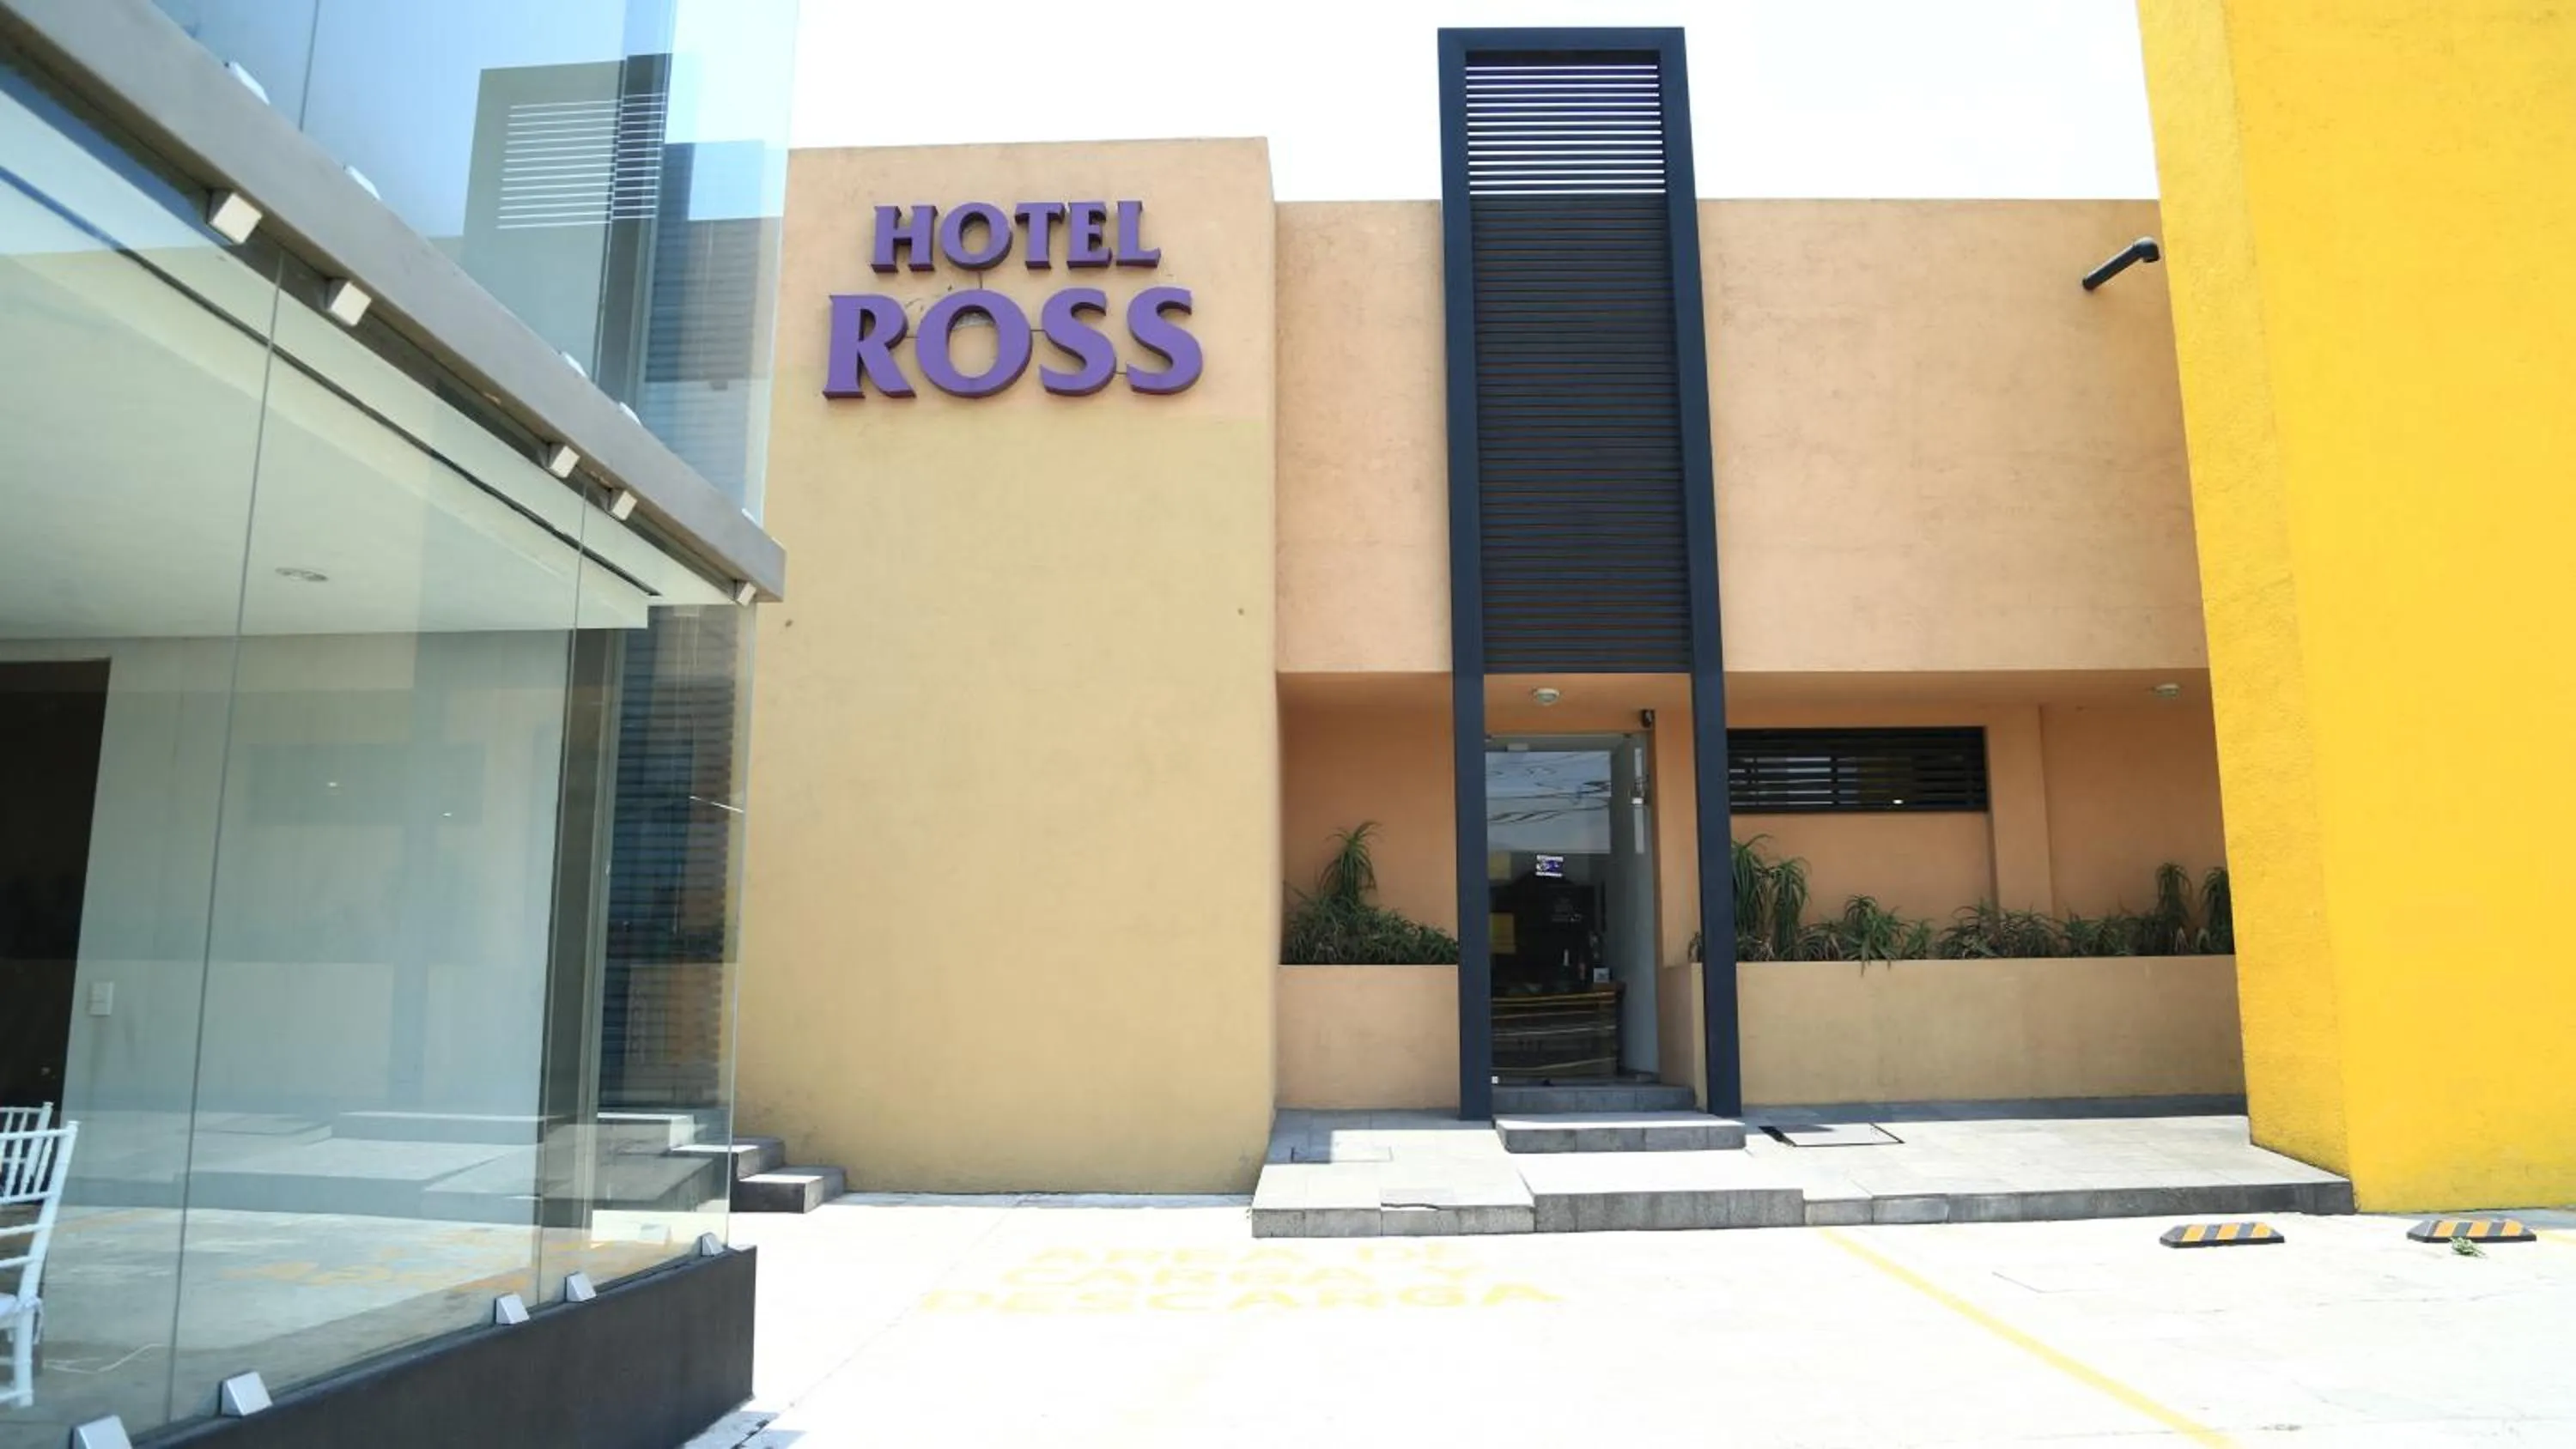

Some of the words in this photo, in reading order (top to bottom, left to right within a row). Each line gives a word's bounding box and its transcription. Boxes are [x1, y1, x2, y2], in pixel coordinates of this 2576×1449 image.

[871, 200, 1161, 273] HOTEL
[822, 286, 1203, 398] ROSS
[920, 1283, 1565, 1313] DESCARGA
